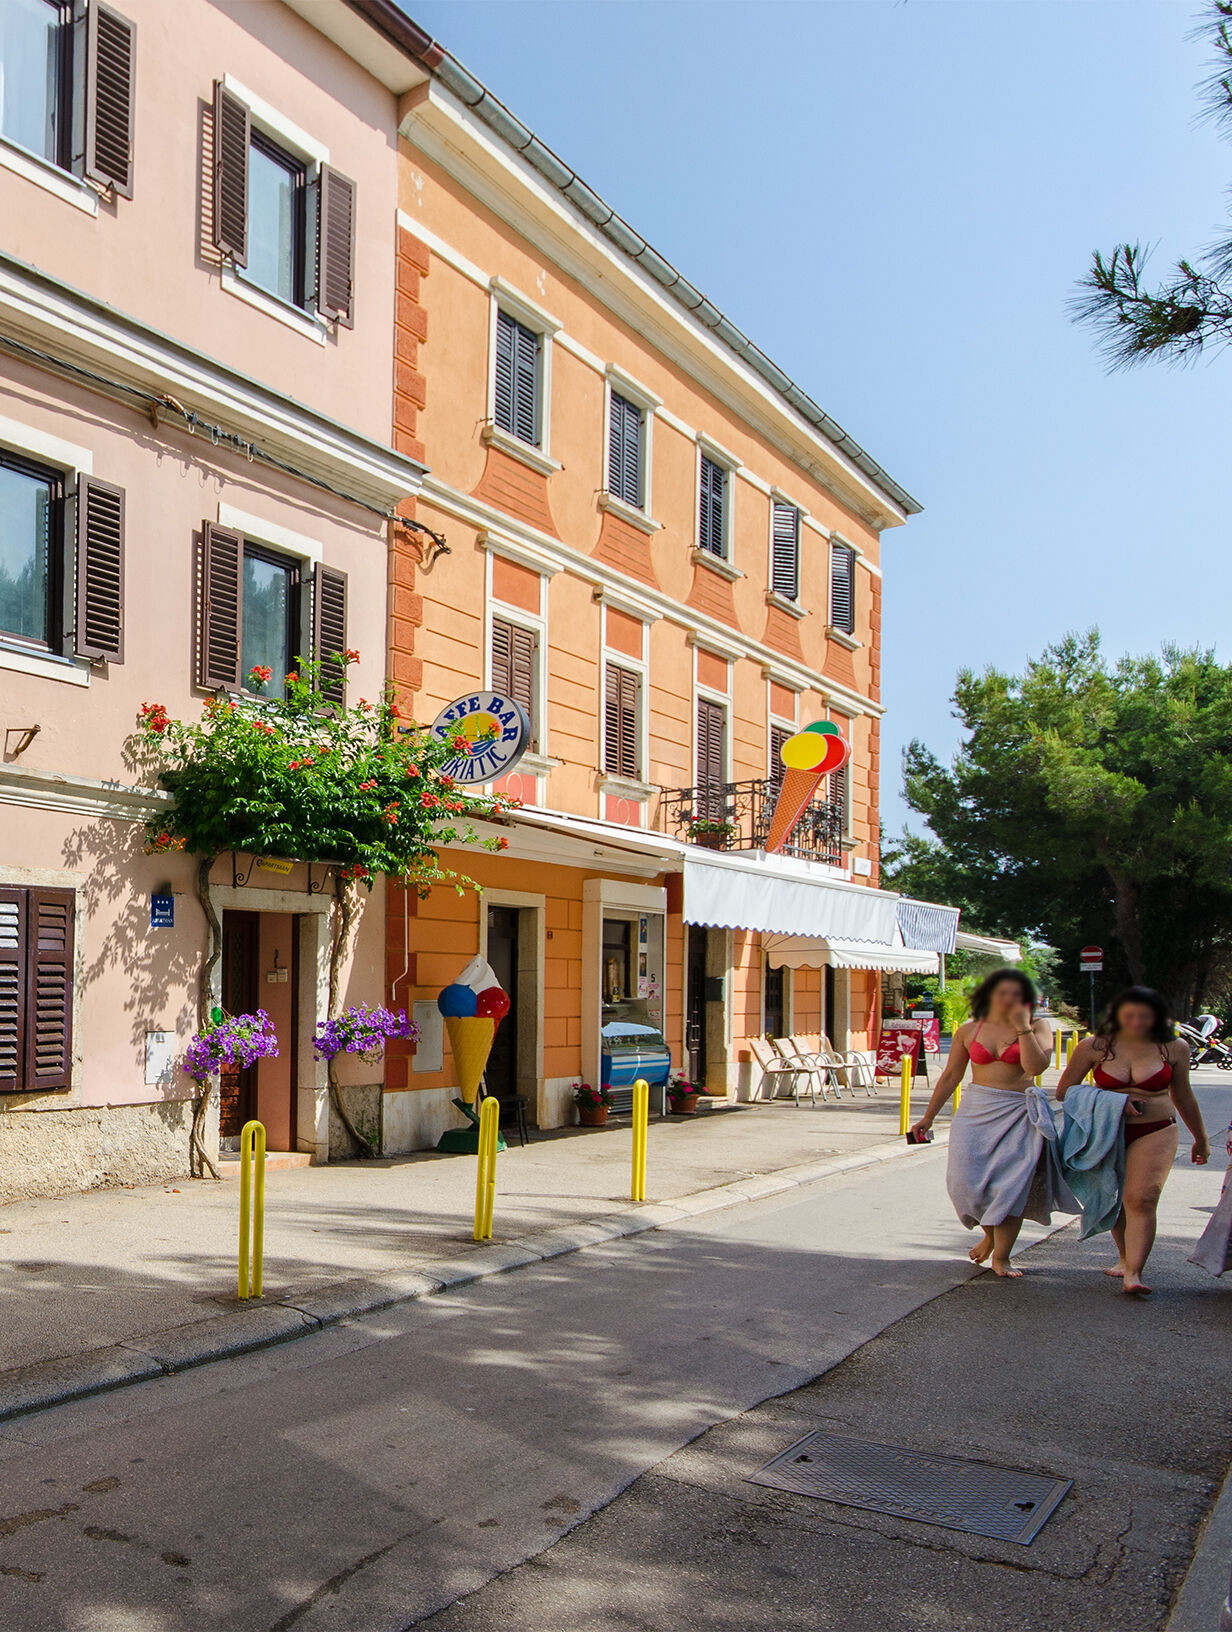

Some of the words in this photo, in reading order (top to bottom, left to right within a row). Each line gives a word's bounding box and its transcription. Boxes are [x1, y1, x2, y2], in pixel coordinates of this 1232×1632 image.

[435, 696, 481, 738] AFFE
[486, 696, 519, 743] BAR
[440, 745, 508, 780] DRIATIC
